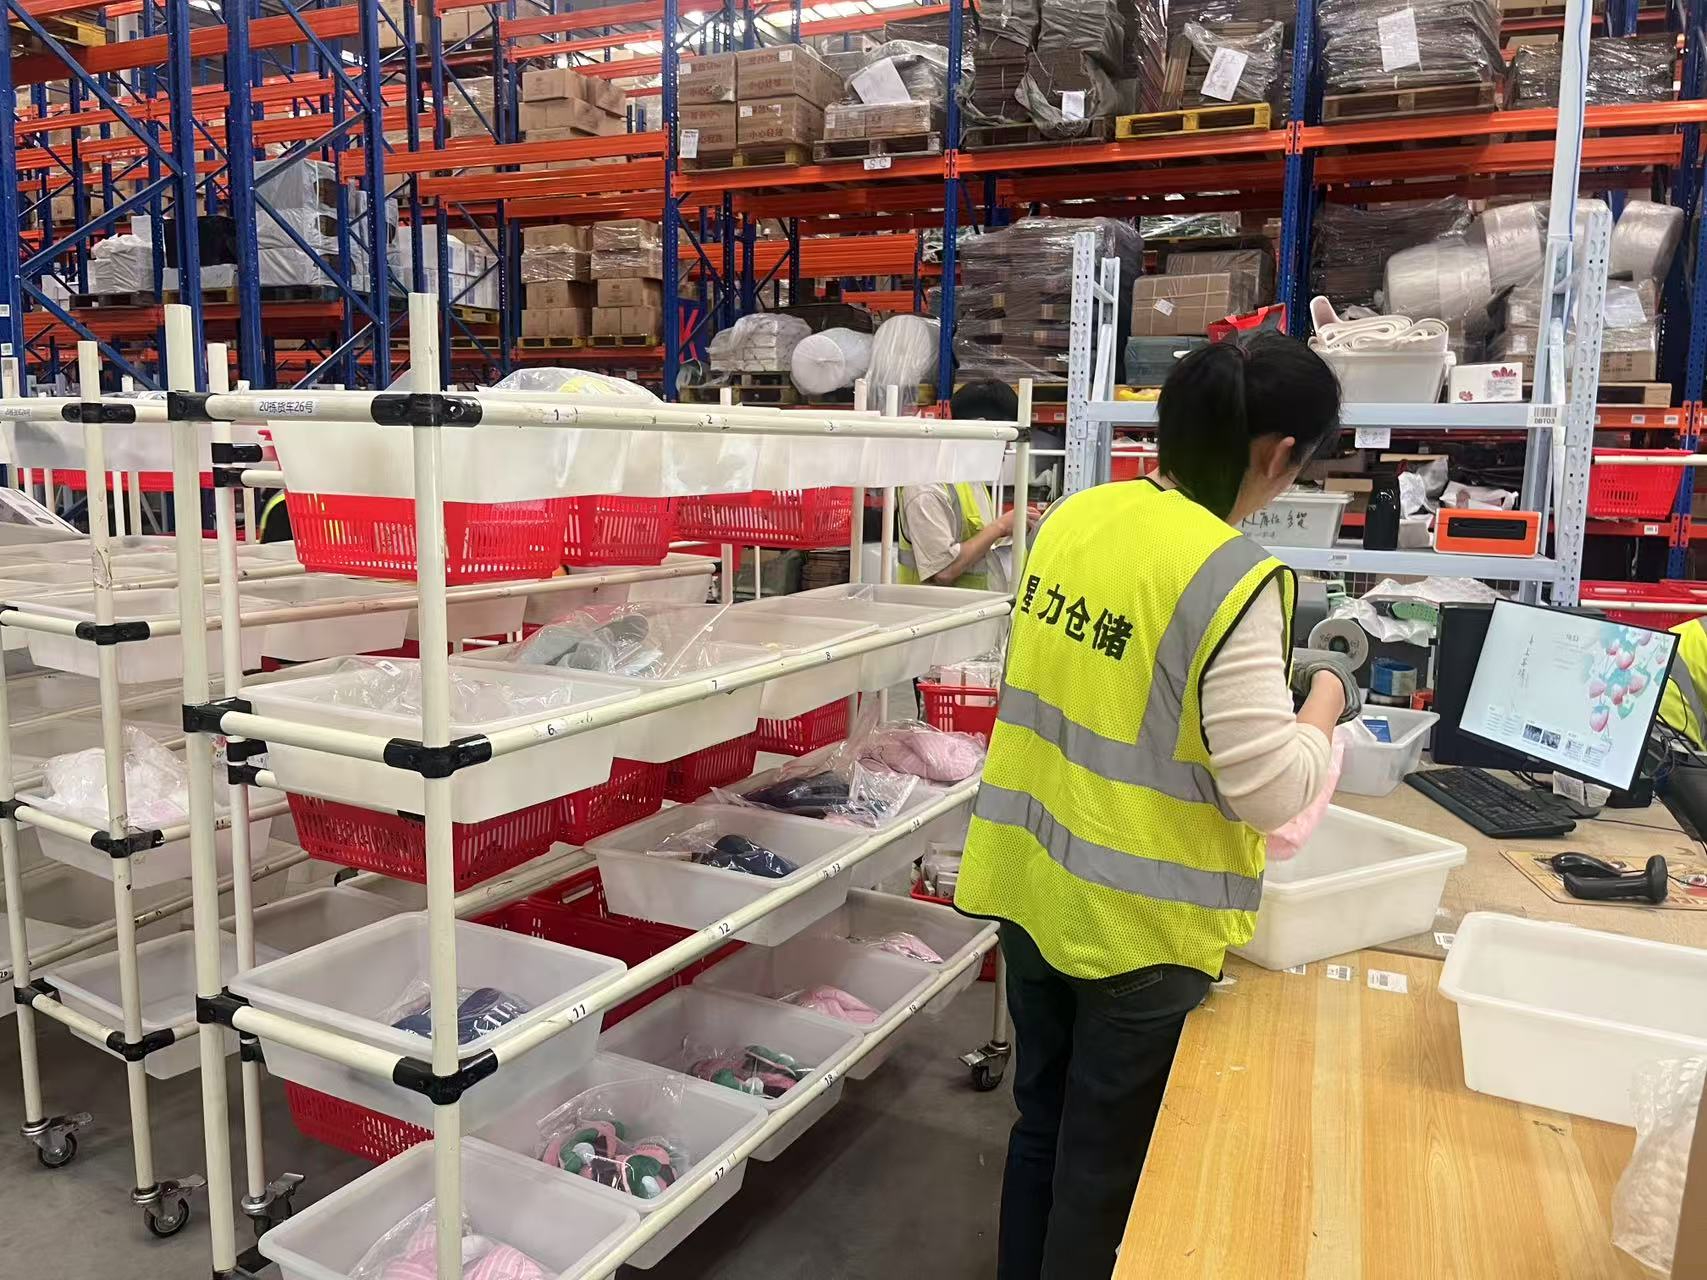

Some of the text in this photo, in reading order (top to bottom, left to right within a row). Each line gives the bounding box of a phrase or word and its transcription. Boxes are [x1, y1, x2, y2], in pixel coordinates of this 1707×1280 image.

[547, 723, 555, 736] 6
[719, 922, 731, 936] 12
[573, 1003, 586, 1018] 11
[715, 1167, 725, 1180] 17
